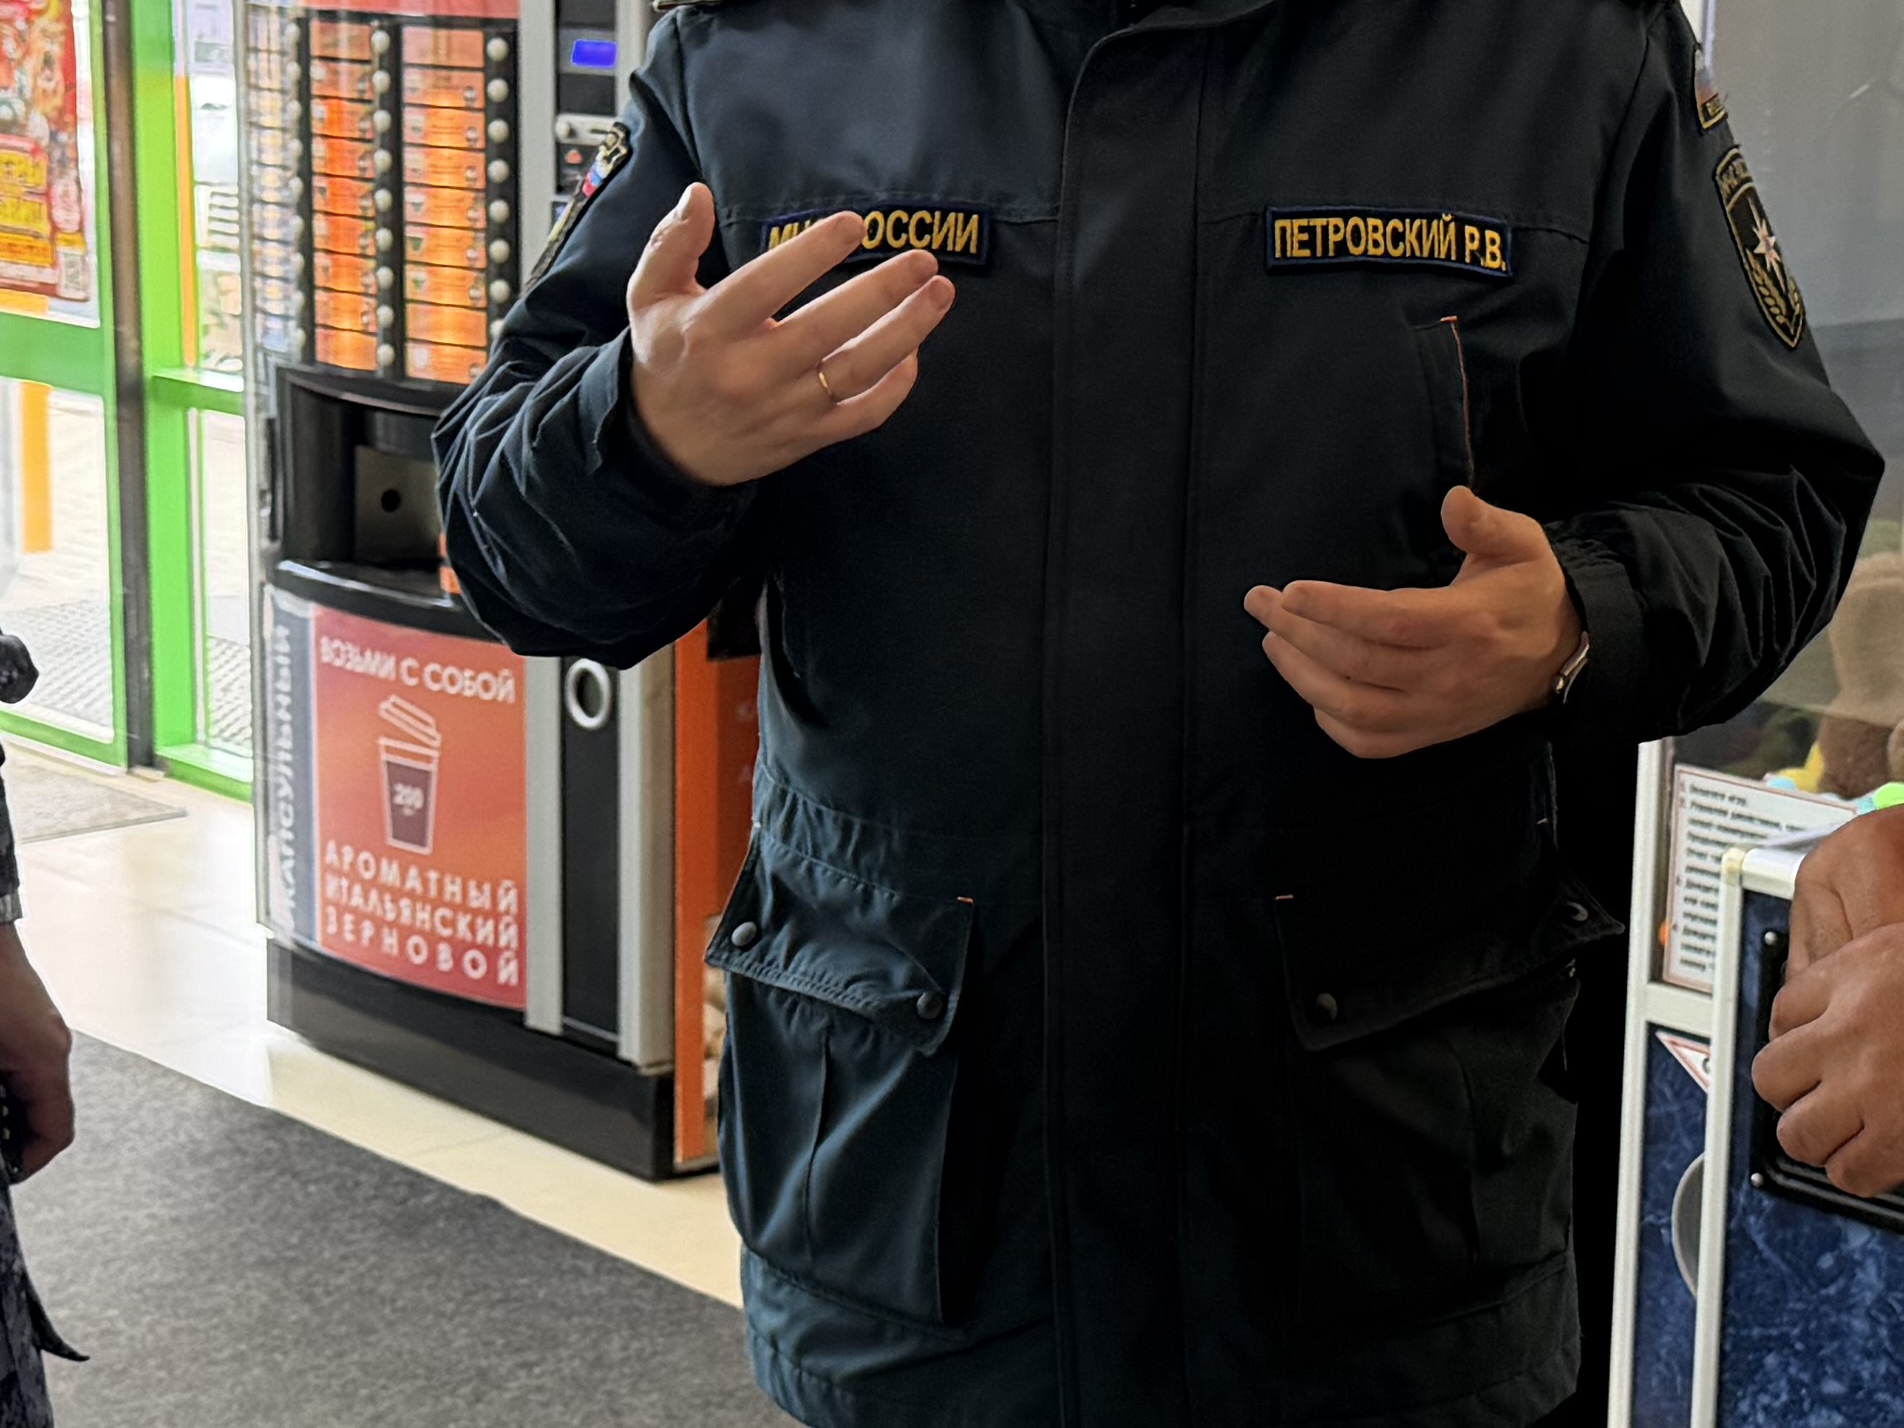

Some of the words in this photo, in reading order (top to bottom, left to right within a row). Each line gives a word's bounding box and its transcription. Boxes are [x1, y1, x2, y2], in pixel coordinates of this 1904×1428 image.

[862, 210, 979, 254] ОССИИ
[1275, 213, 1456, 261] ПЕТРОВСКИЙ
[1465, 225, 1507, 271] Р.В.
[320, 636, 396, 681] ВОЗЬМИ
[400, 657, 420, 686] С
[423, 662, 516, 704] СОБОЙ
[325, 839, 518, 914] АРОМАТНЫЙ
[325, 872, 518, 950] ИТАЛЬЯНСКИЙ
[325, 905, 519, 987] ЗЕРНОВОЙ
